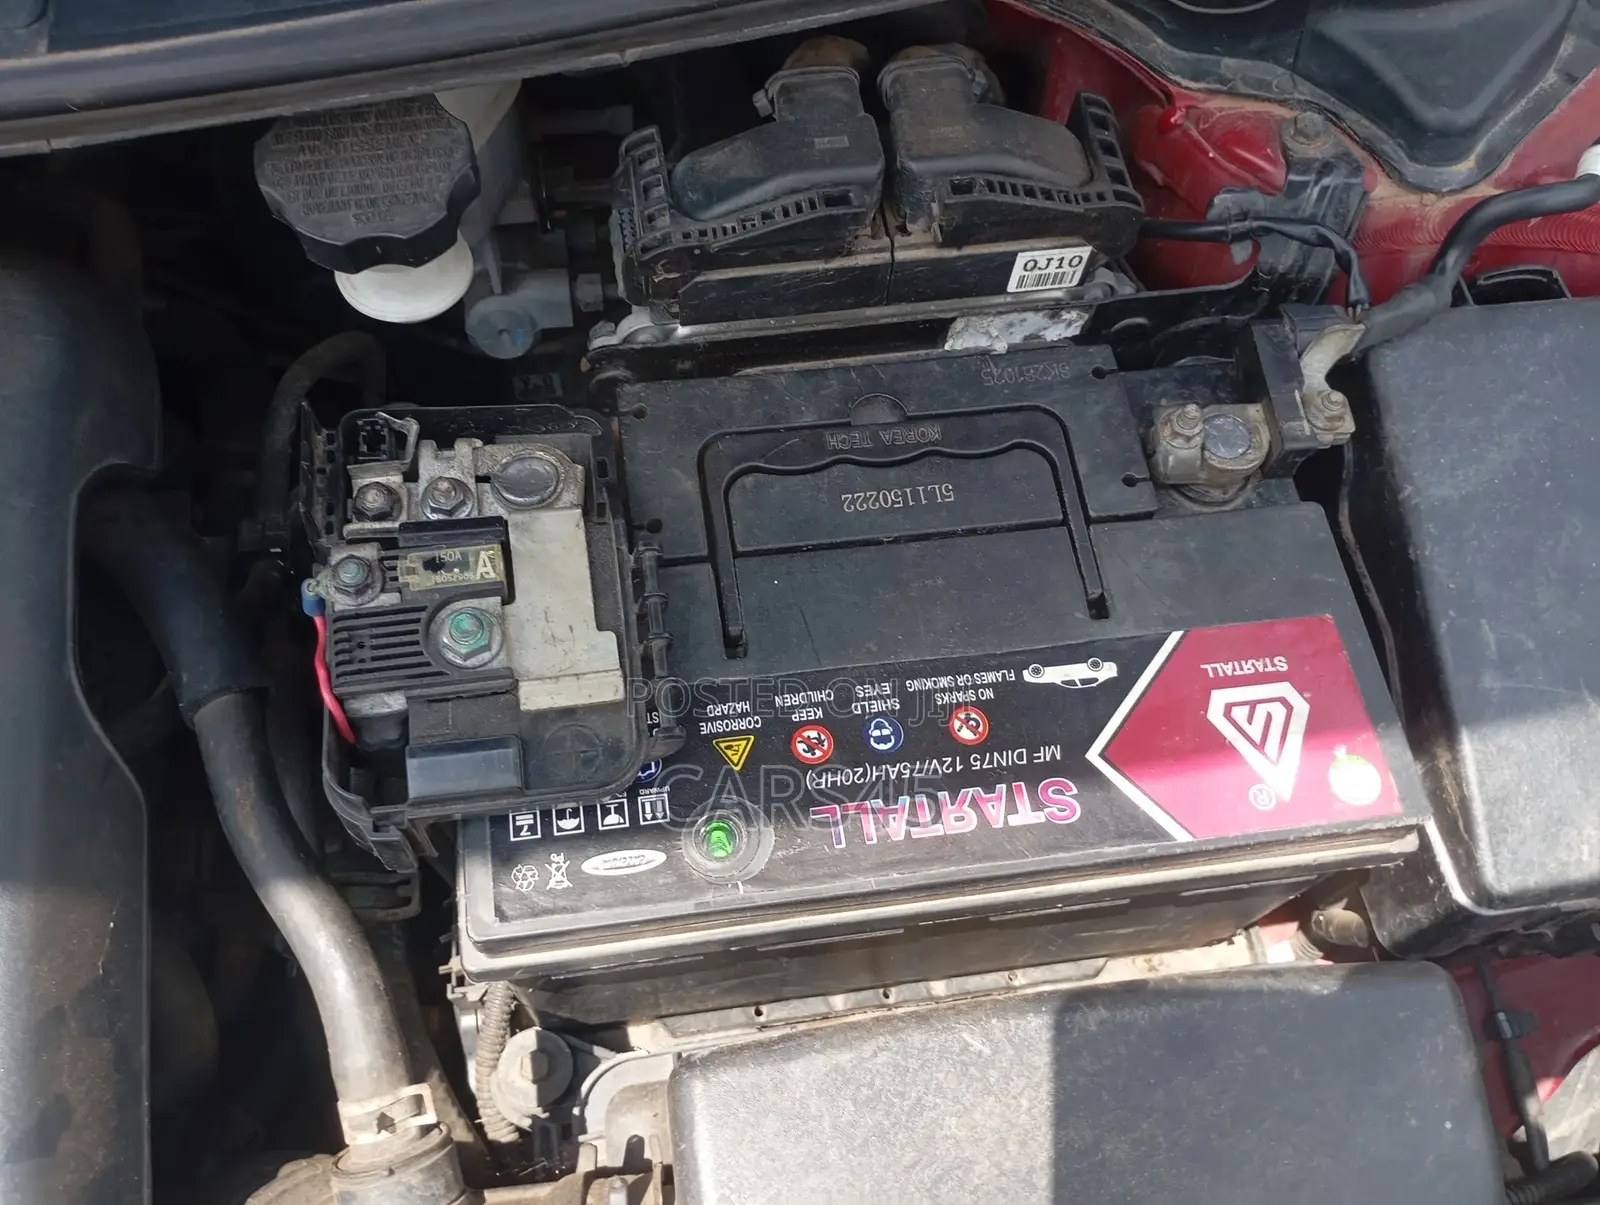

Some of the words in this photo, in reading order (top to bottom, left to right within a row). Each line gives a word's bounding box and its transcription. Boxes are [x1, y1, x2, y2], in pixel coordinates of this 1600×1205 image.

[825, 430, 874, 450] TECH
[878, 424, 942, 446] KOREA
[841, 483, 955, 512] 5L1150222
[1199, 655, 1289, 678] STARTALL
[905, 676, 955, 693] SMOKING
[955, 673, 973, 688] OR
[973, 668, 1016, 685] FLAMES
[774, 689, 834, 708] CHILDREN
[855, 682, 892, 698] EYES
[934, 689, 976, 706] SPARKS
[978, 687, 995, 700] NO
[706, 700, 751, 717] HAZARD
[791, 706, 824, 722] KEEP
[851, 698, 901, 715] SHIELD
[699, 715, 762, 735] CORROSIVE
[969, 748, 1027, 770] DIN75
[1032, 744, 1061, 764] MF
[805, 756, 964, 790] 12V/75AH(20HR)
[639, 785, 670, 795] UPWARD
[809, 777, 1082, 849] STARTALL
